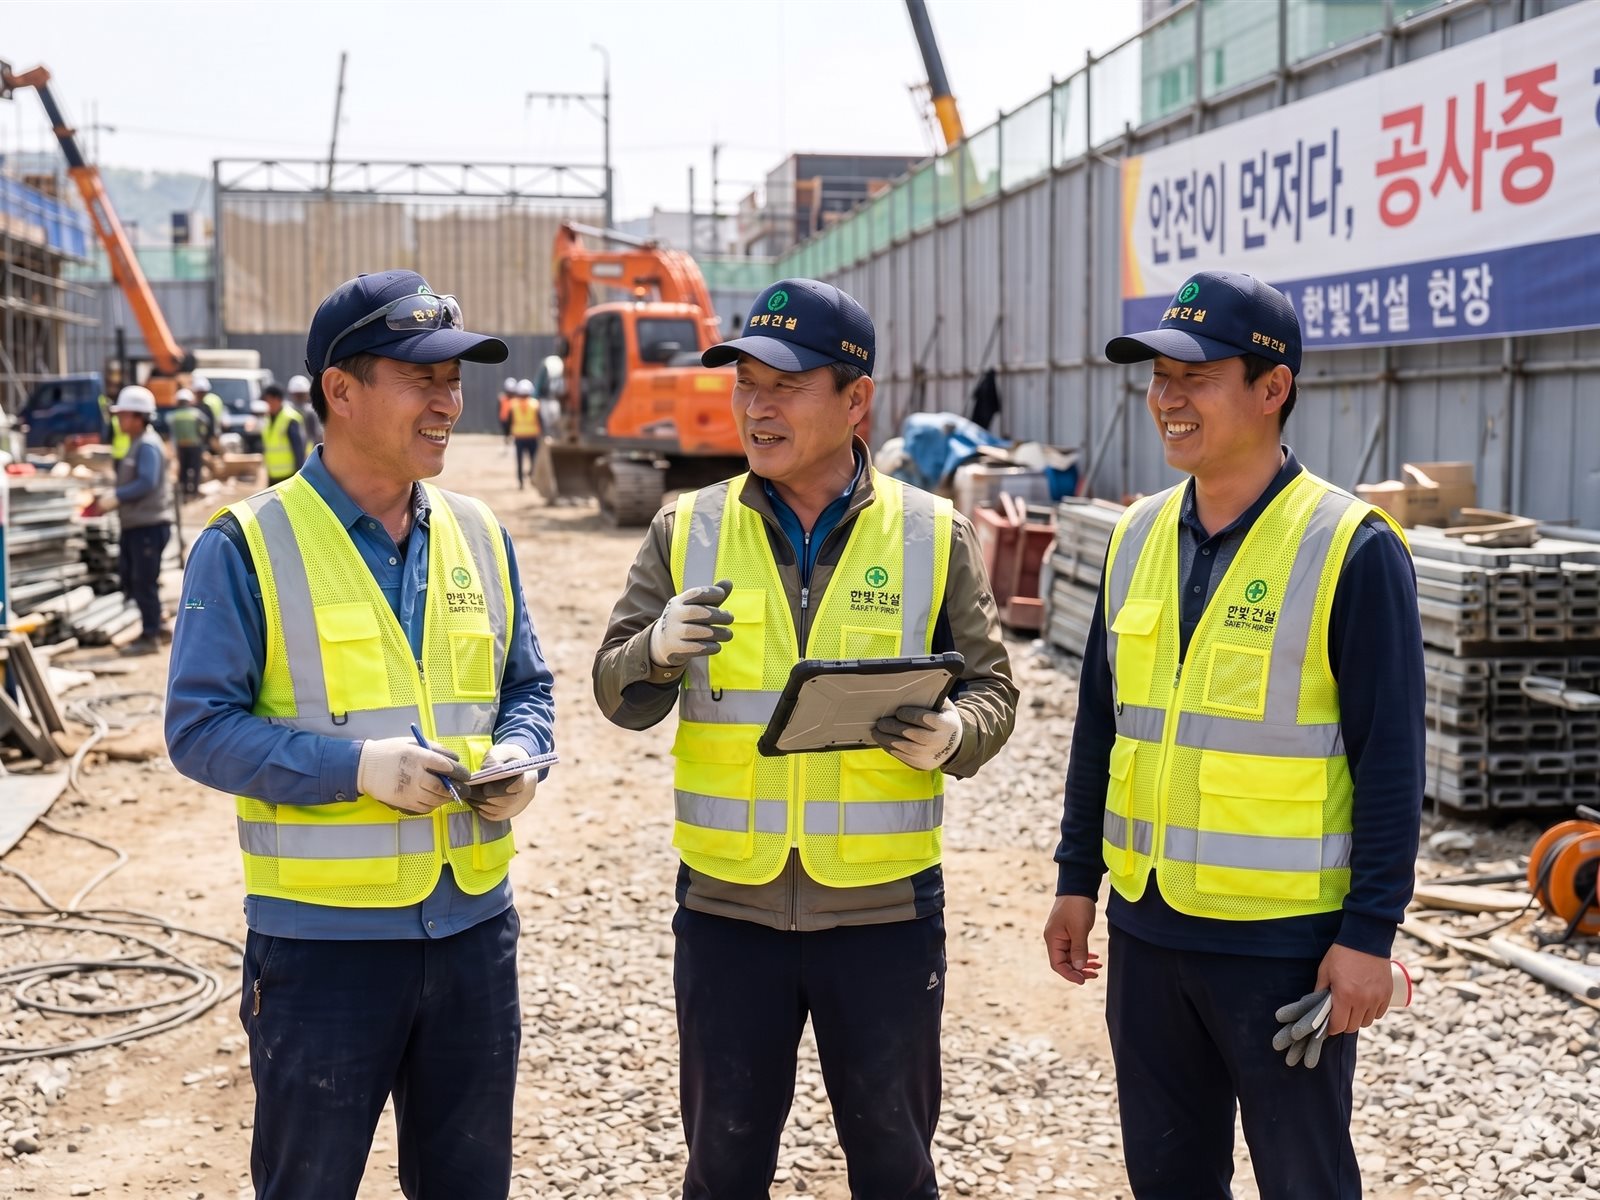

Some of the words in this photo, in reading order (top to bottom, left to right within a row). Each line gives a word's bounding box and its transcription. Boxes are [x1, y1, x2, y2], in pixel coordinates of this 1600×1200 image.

[1149, 163, 1225, 265] 안전이
[1240, 127, 1354, 250] 먼저다,
[1375, 62, 1563, 229] 공사중
[1302, 273, 1410, 339] 한빛건설
[1428, 262, 1493, 329] 현장
[850, 590, 900, 607] 한빛건설
[1227, 605, 1276, 625] 한빛건설
